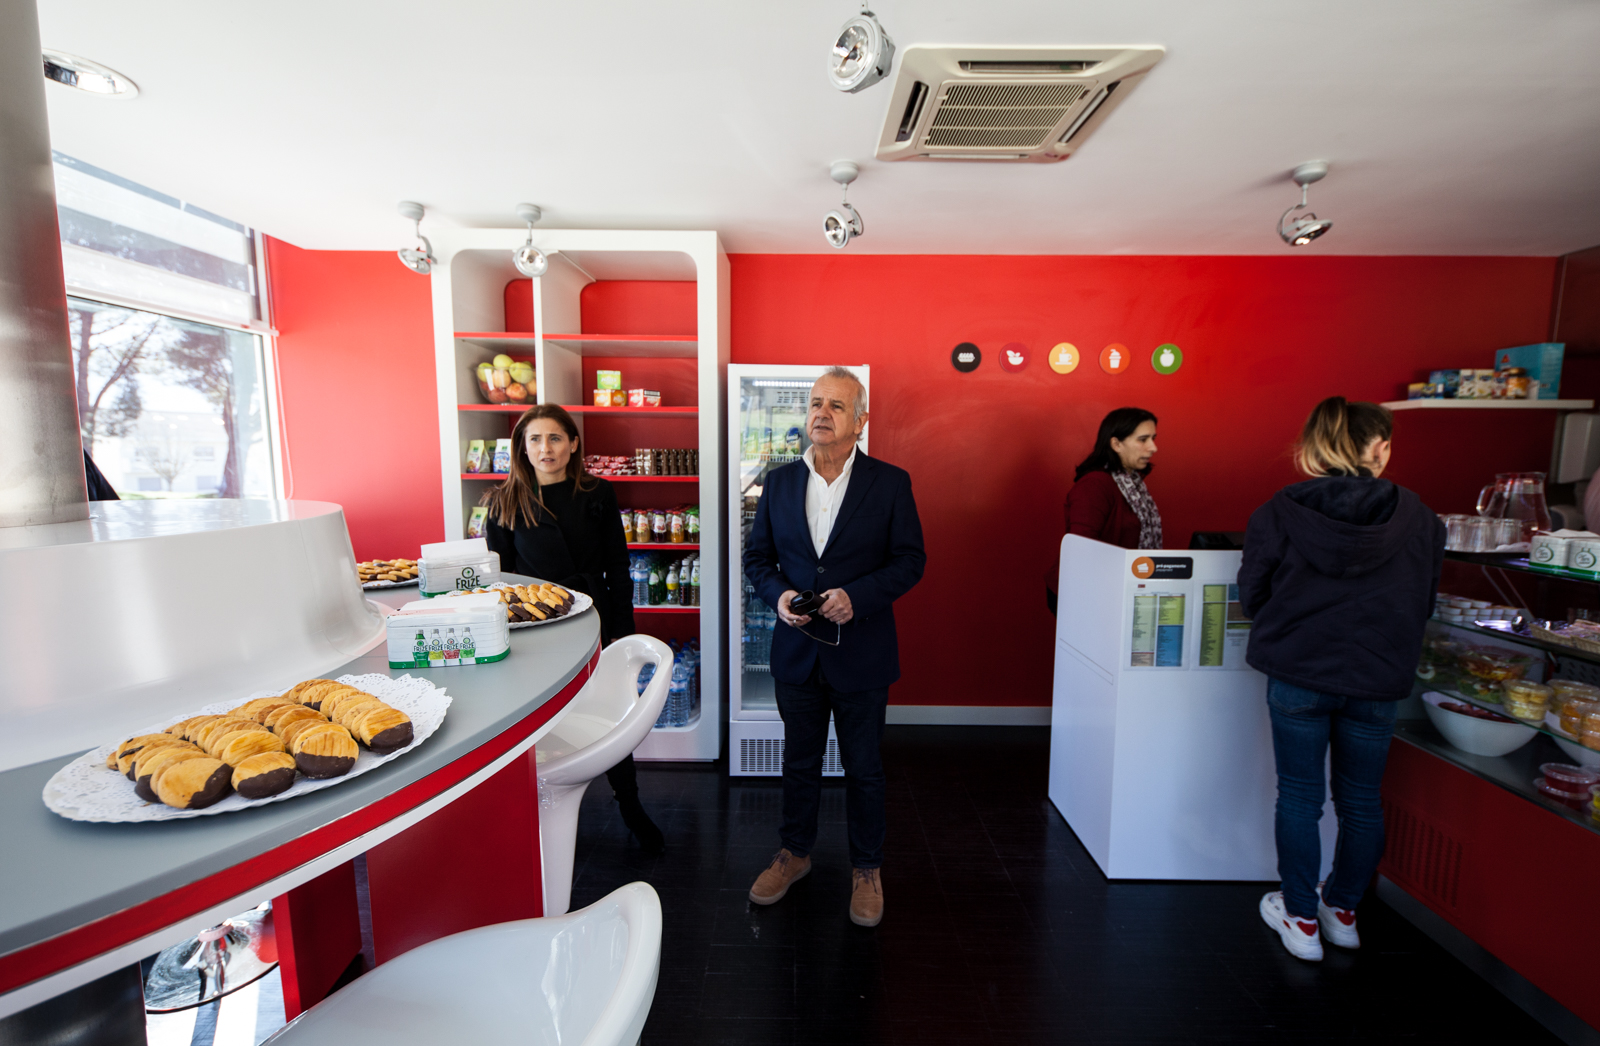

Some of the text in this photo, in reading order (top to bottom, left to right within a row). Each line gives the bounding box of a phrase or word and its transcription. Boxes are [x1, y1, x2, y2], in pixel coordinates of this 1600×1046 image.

[455, 575, 481, 590] FRIZE
[413, 644, 428, 652] FRIZE
[429, 644, 443, 652] FRIZE
[444, 643, 459, 651] FRIZE
